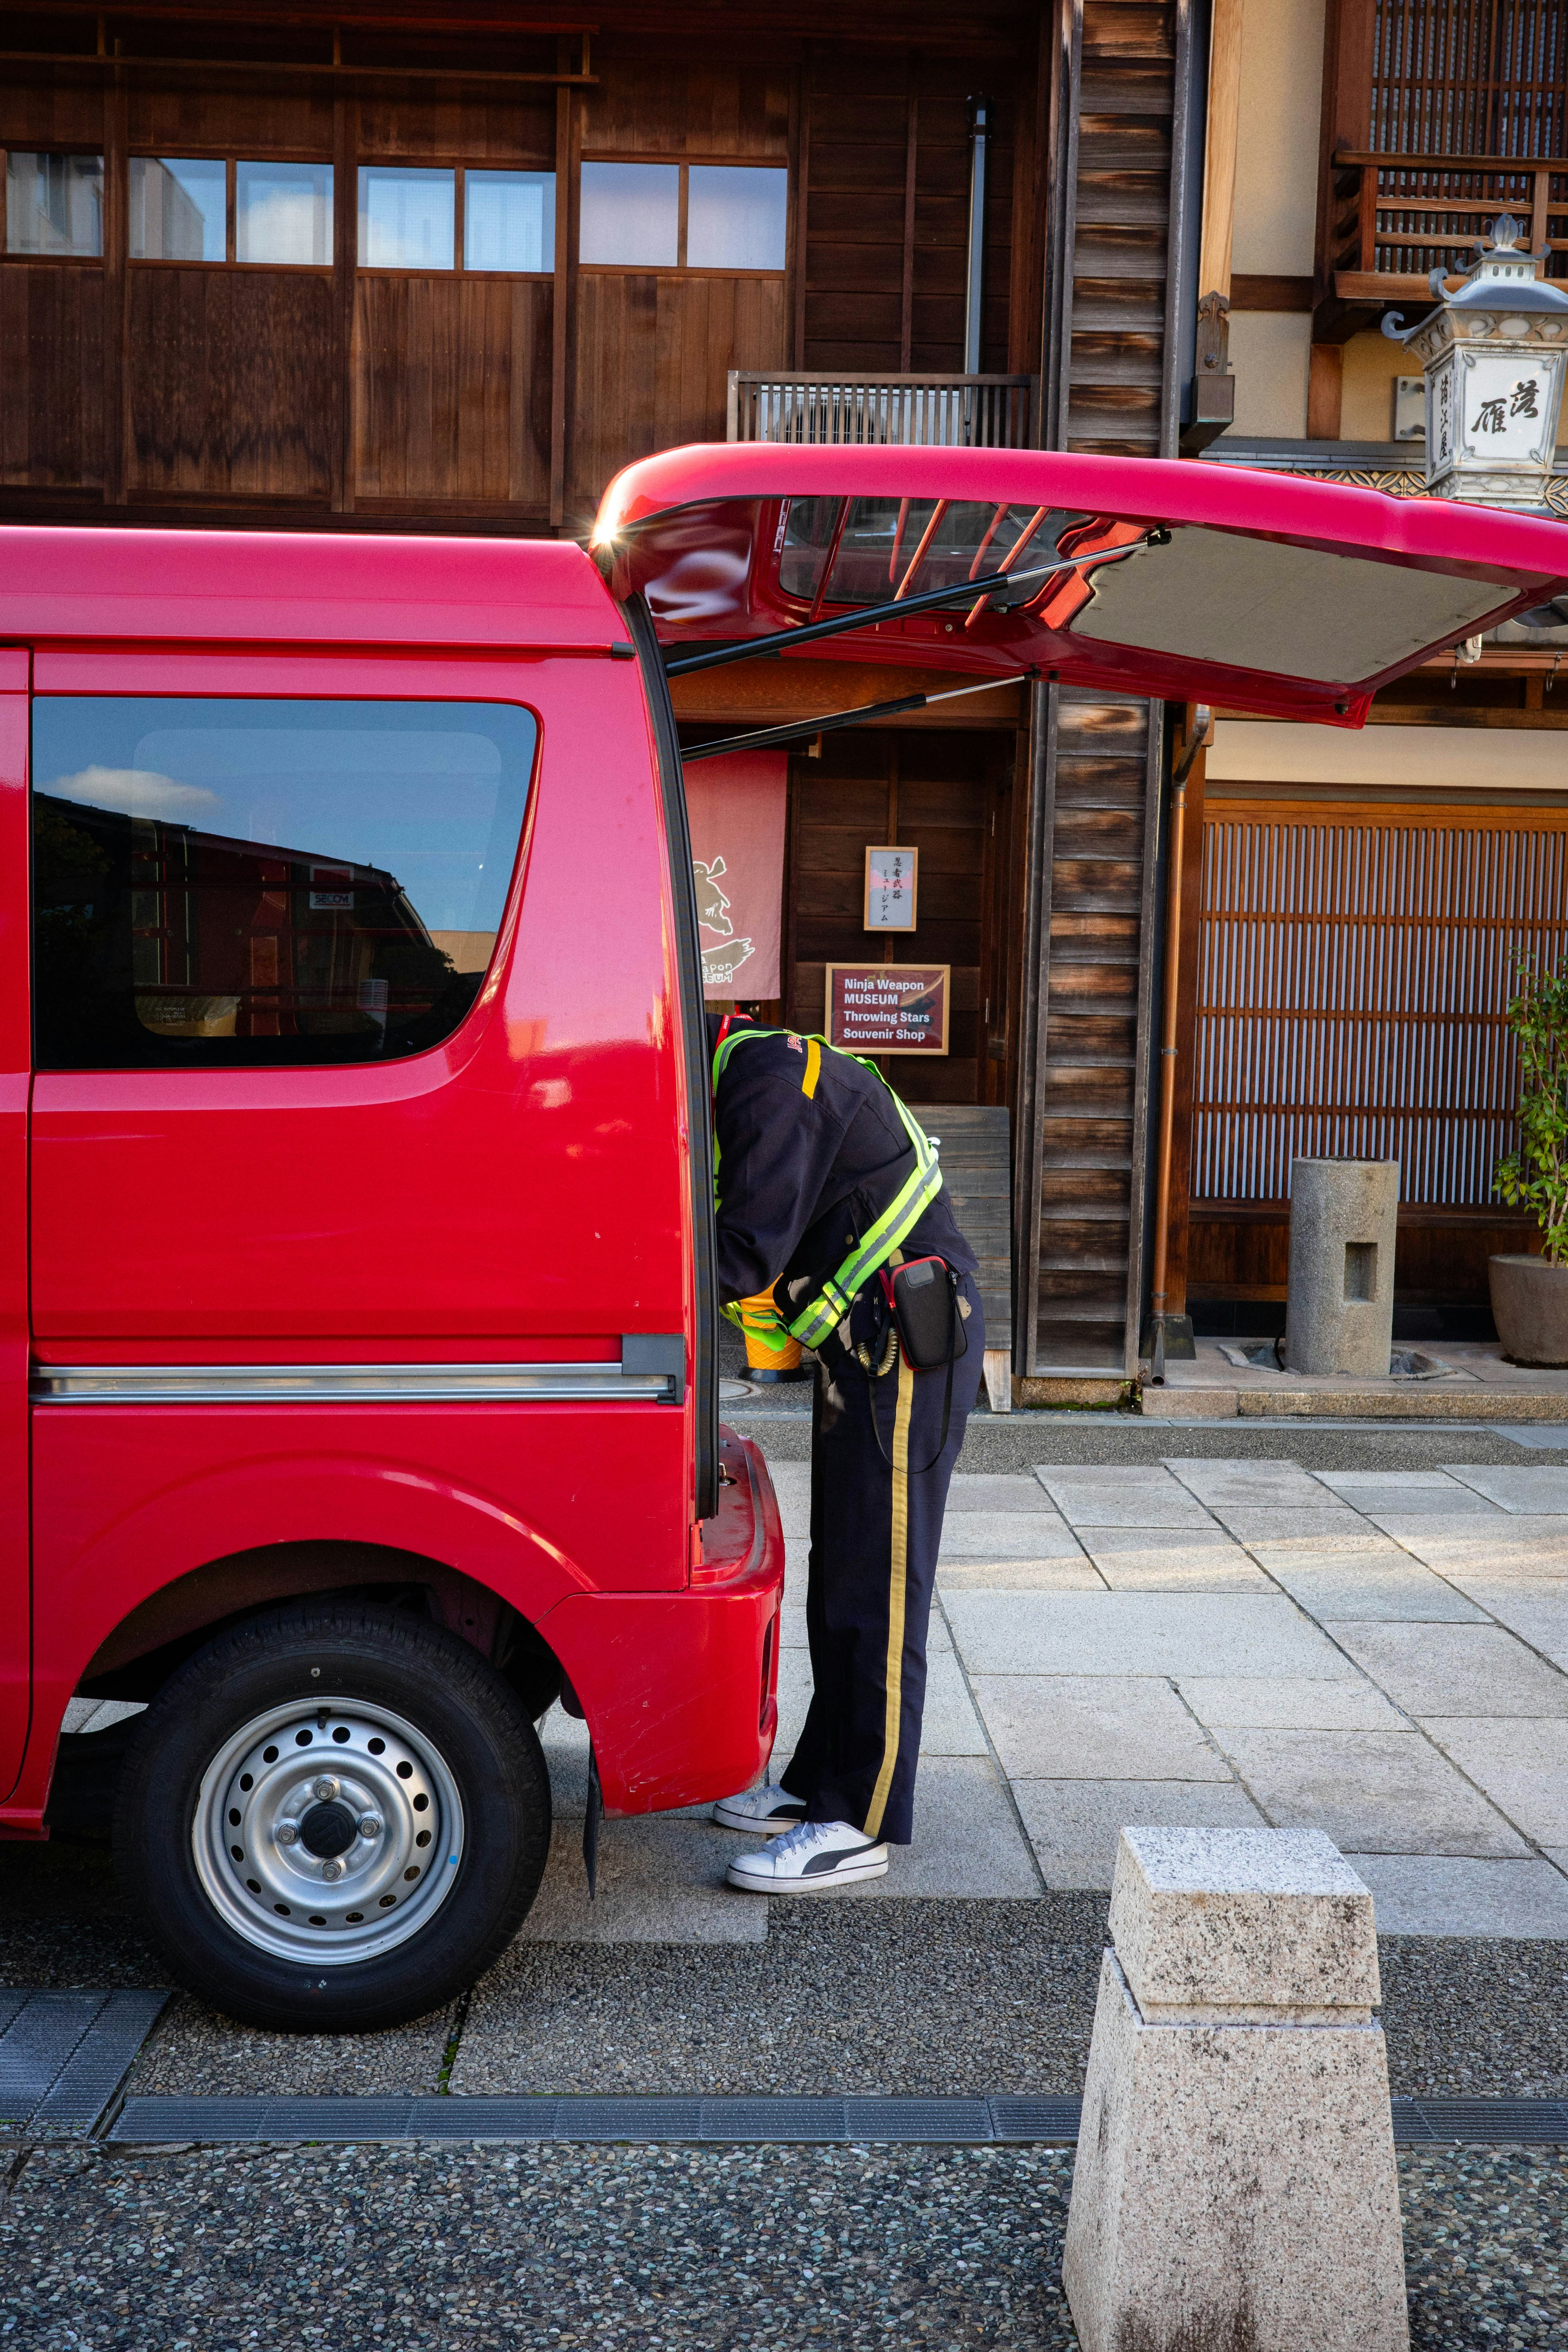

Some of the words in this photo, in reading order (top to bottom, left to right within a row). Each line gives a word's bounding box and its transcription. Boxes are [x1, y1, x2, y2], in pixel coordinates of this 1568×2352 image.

[893, 857, 902, 899] 忍者武器
[316, 895, 349, 904] SECOM
[703, 963, 732, 973] apon
[845, 979, 874, 992] Ninja
[877, 980, 924, 992] Weapon
[844, 993, 898, 1004] MUSEUM
[844, 1011, 898, 1025] Throwing
[900, 1012, 930, 1022] Stars
[843, 1028, 894, 1039] Souvenir
[896, 1029, 925, 1042] Shop
